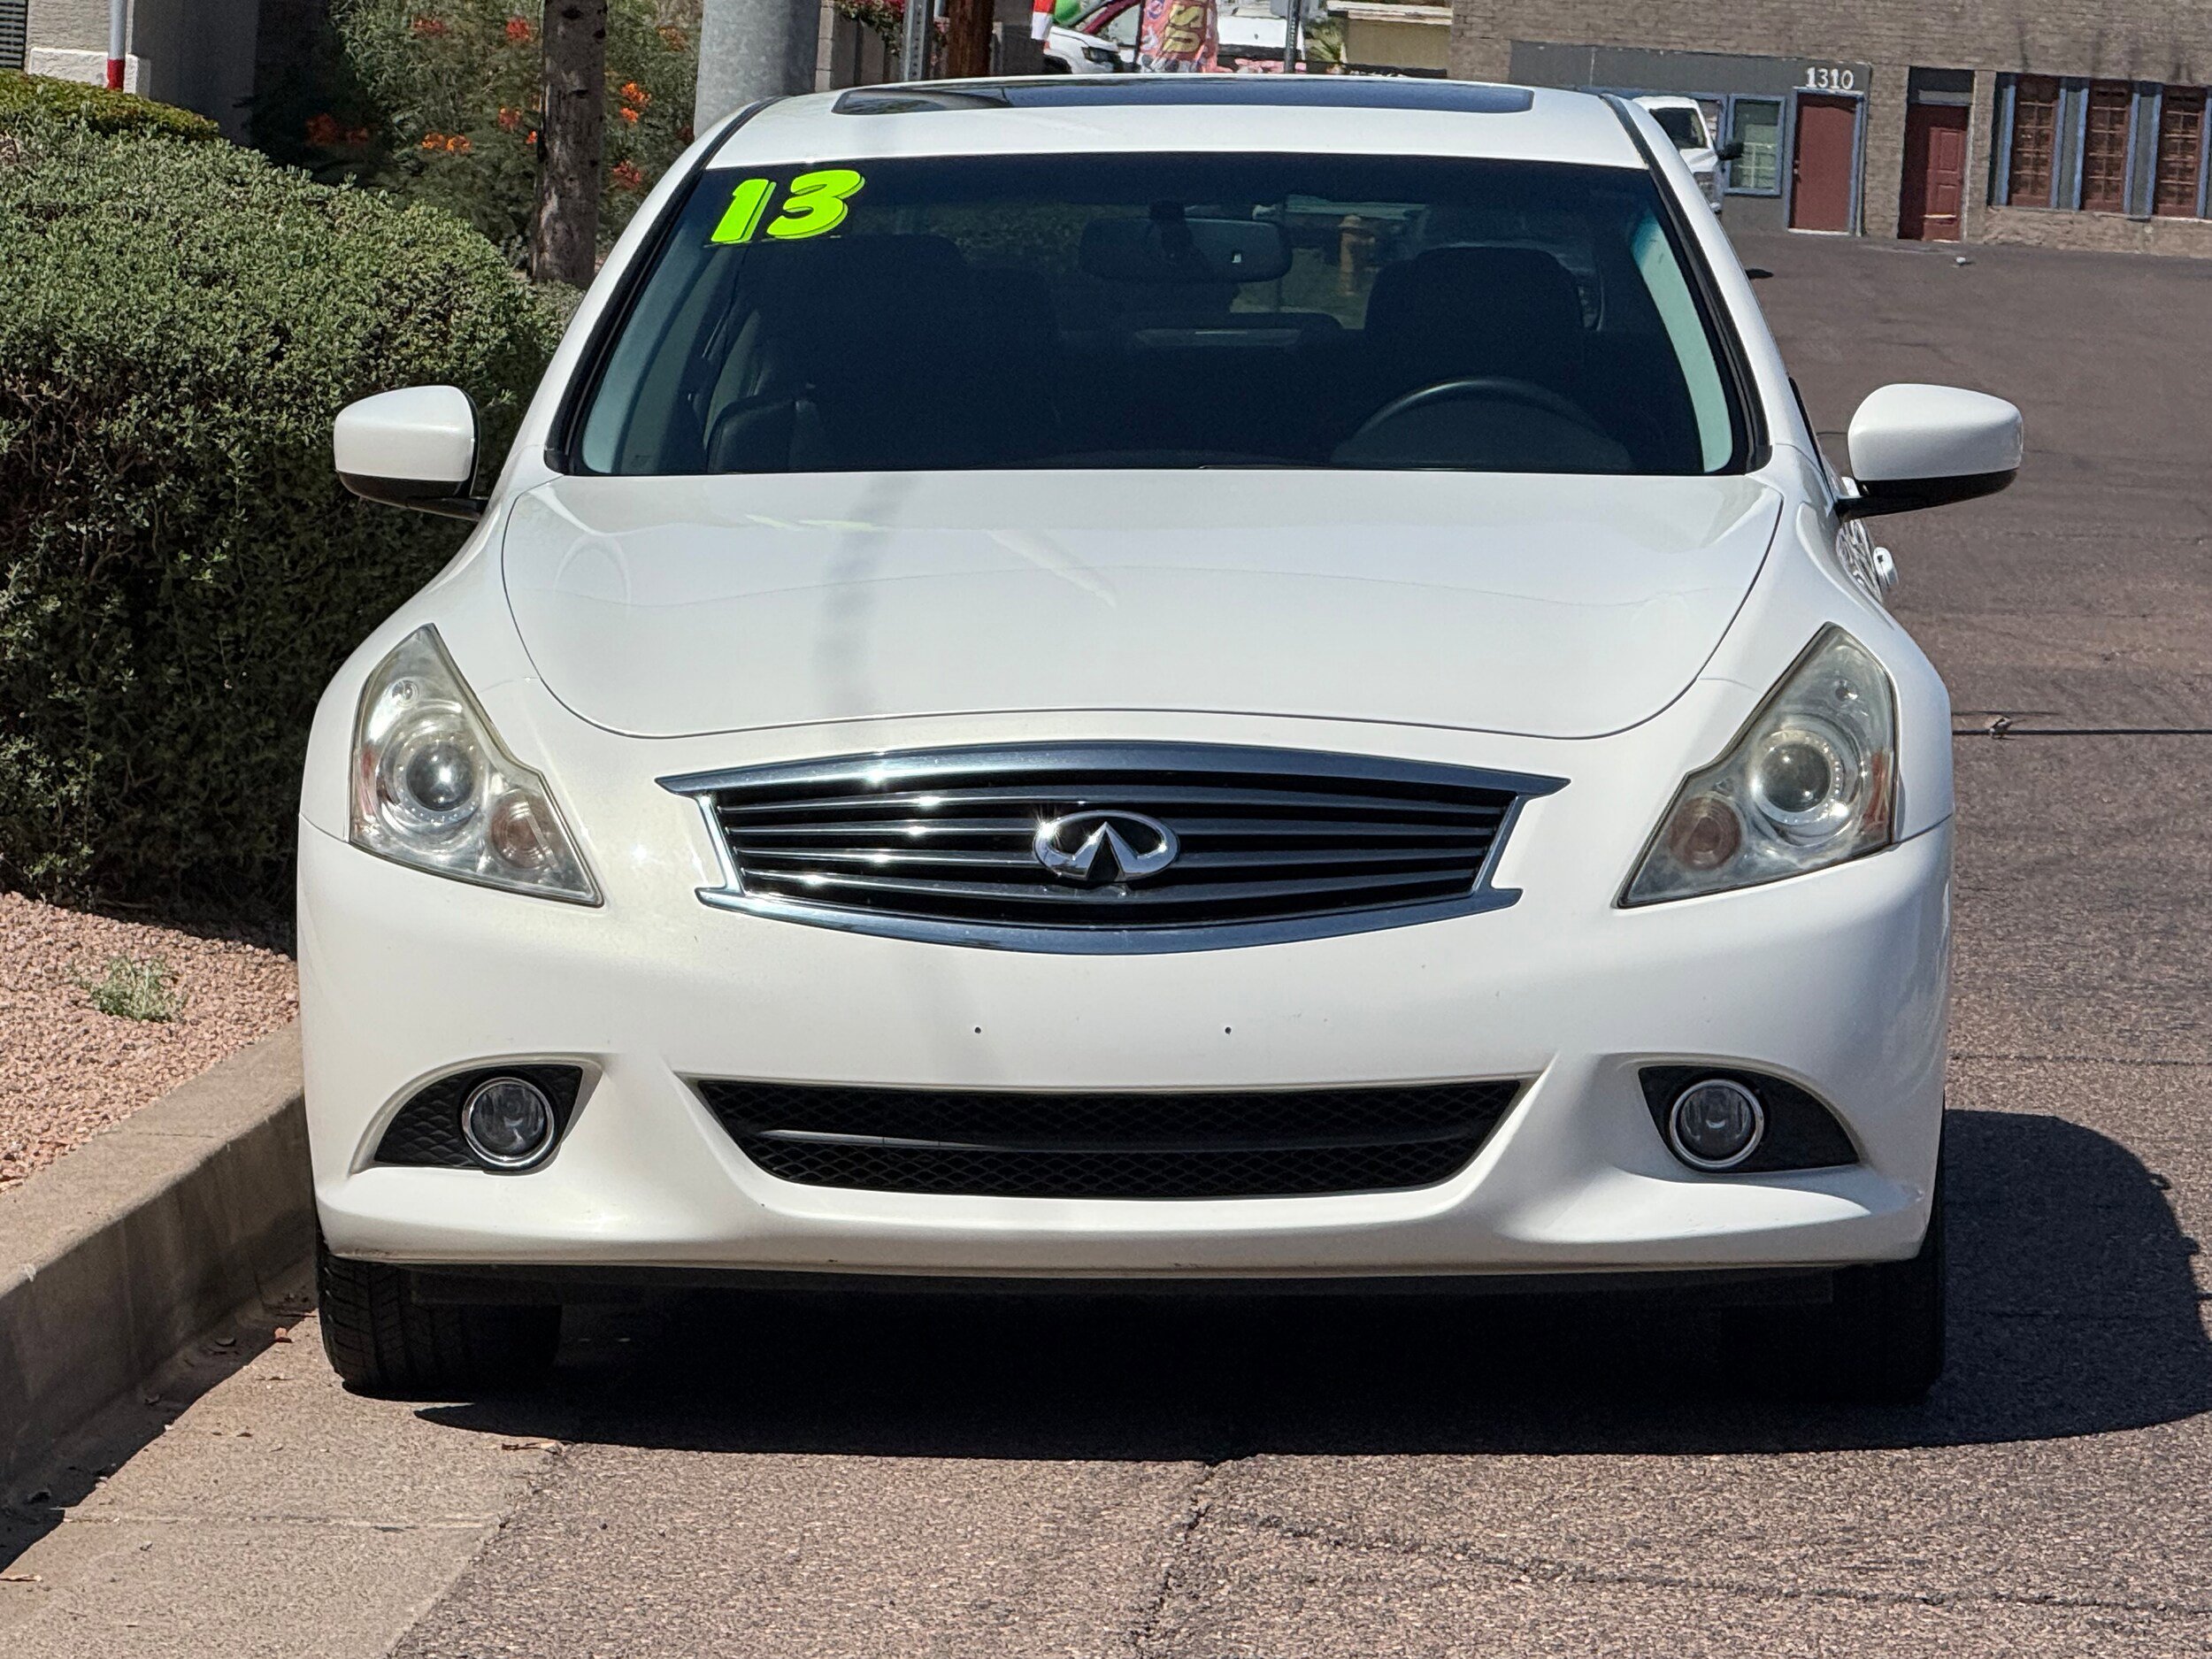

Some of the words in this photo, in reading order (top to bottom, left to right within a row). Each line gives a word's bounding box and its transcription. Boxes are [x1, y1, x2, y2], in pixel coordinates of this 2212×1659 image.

[1162, 0, 1204, 52] US
[1806, 66, 1855, 90] 1310
[710, 169, 865, 244] 13
